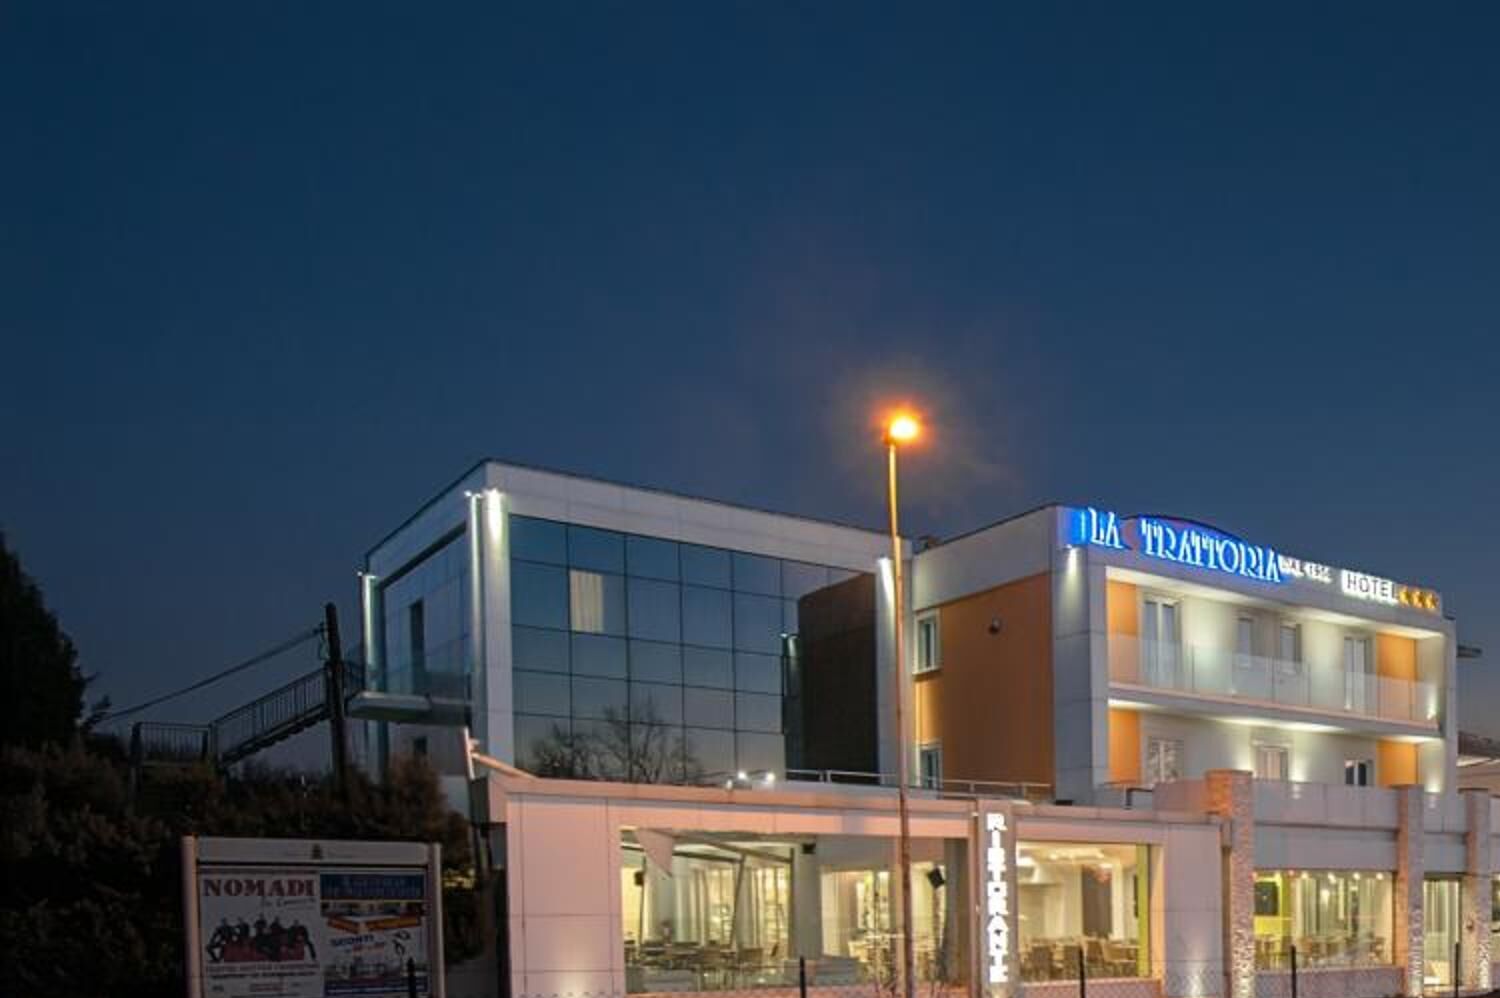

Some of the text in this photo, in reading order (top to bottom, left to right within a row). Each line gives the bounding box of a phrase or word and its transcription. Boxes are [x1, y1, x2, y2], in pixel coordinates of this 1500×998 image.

[1088, 507, 1280, 583] LA TRATTORIA
[1344, 571, 1398, 603] HOTEL
[203, 879, 315, 896] NOMADI
[986, 813, 1009, 983] RISTORANTE
